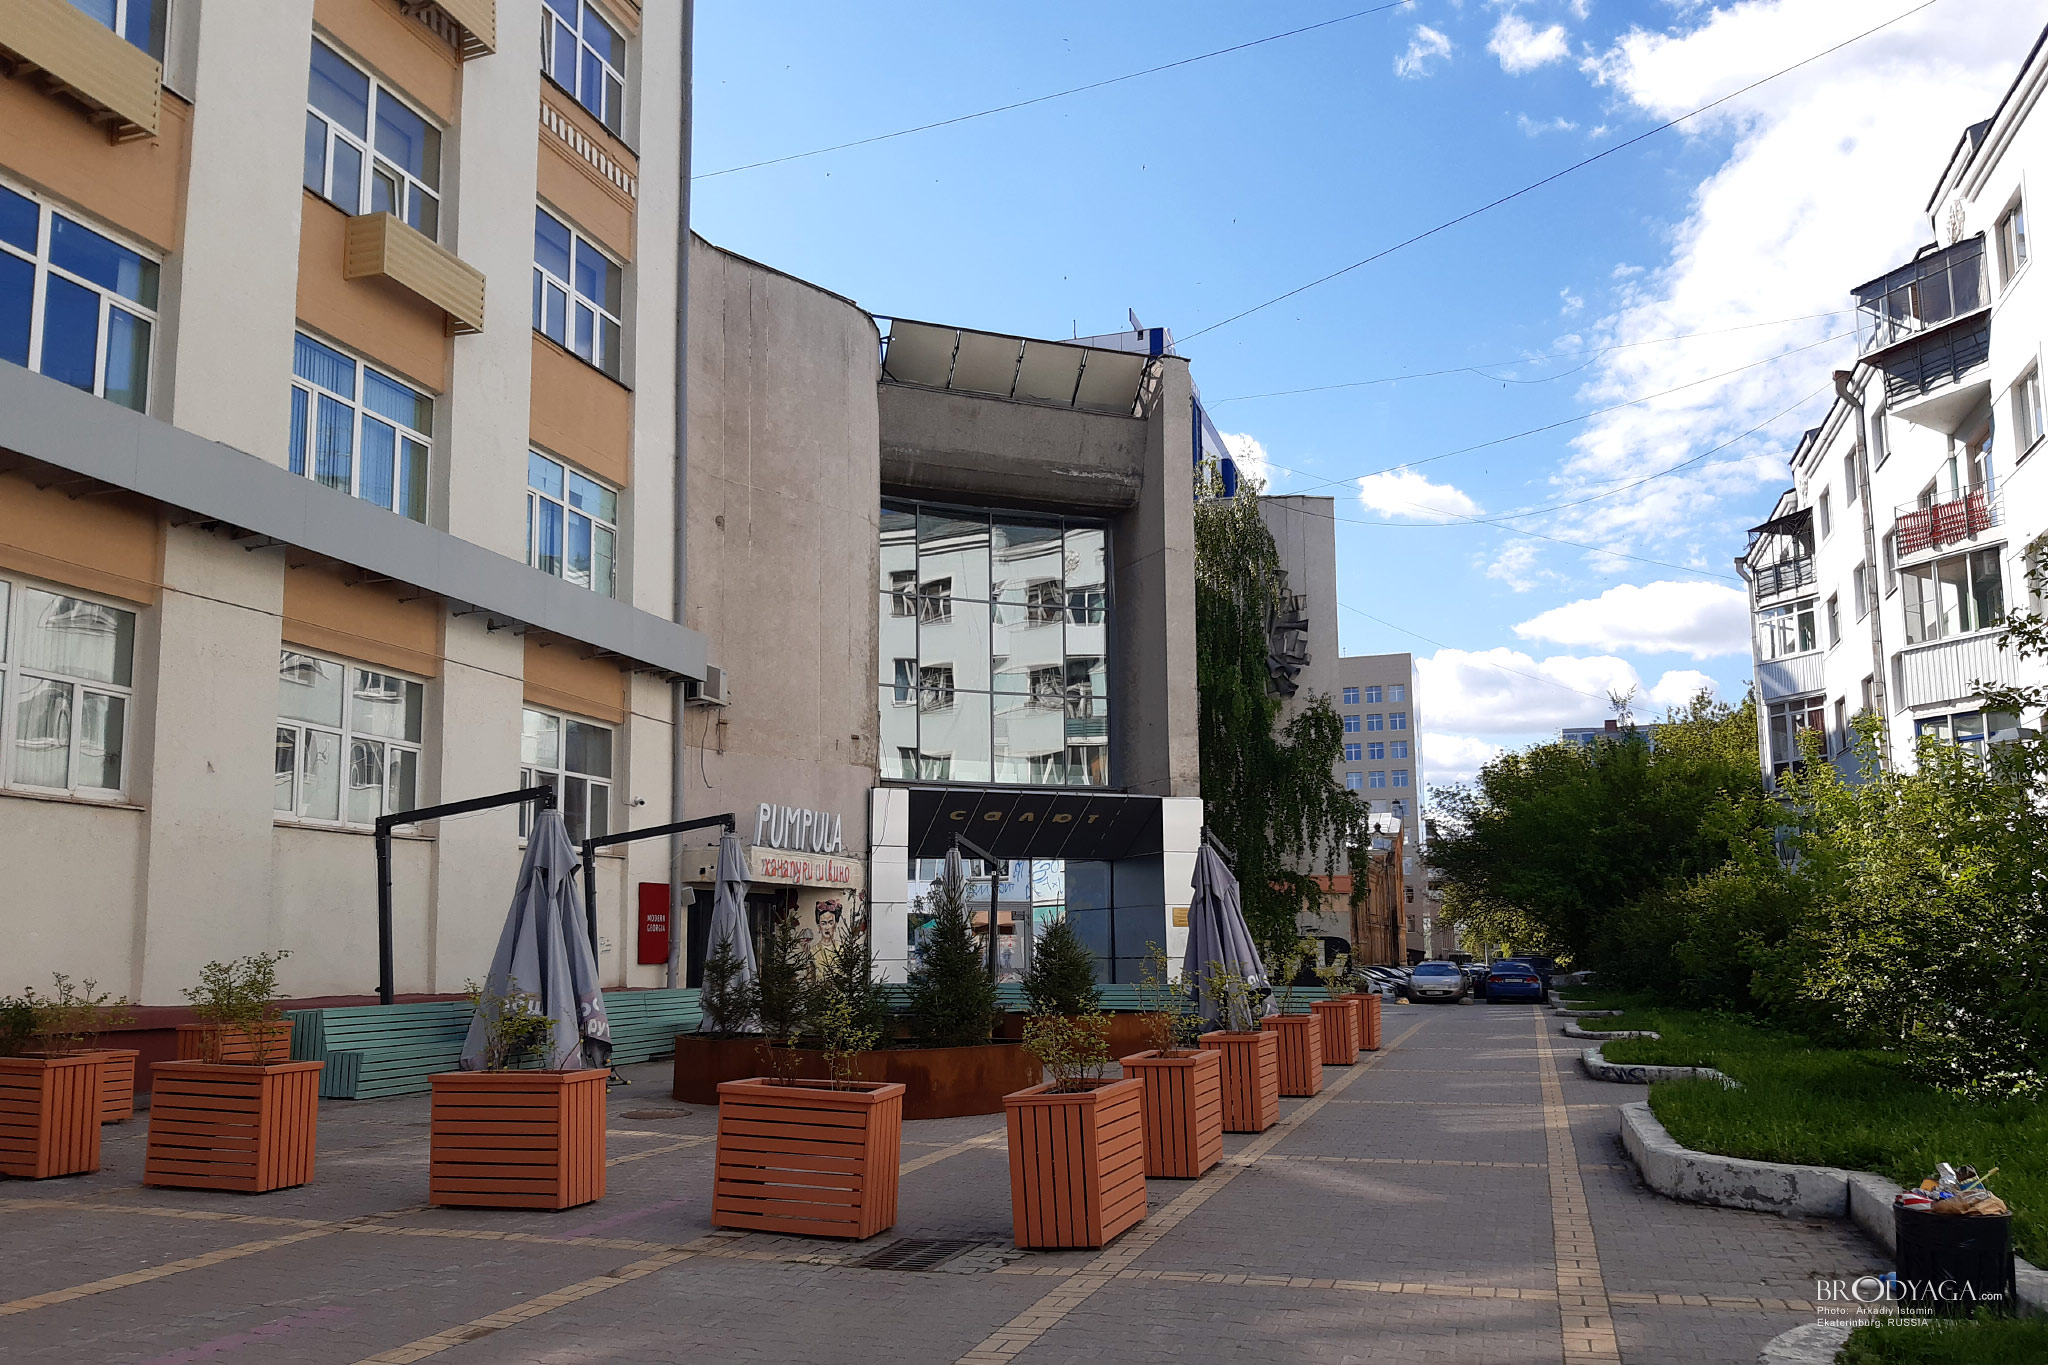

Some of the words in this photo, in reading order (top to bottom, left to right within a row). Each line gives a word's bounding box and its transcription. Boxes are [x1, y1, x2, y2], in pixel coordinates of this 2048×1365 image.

[755, 802, 842, 853] PUMPULA
[763, 858, 813, 885] хачапури
[816, 863, 824, 881] и
[647, 914, 666, 922] MODERN
[647, 924, 666, 932] GEORGIA
